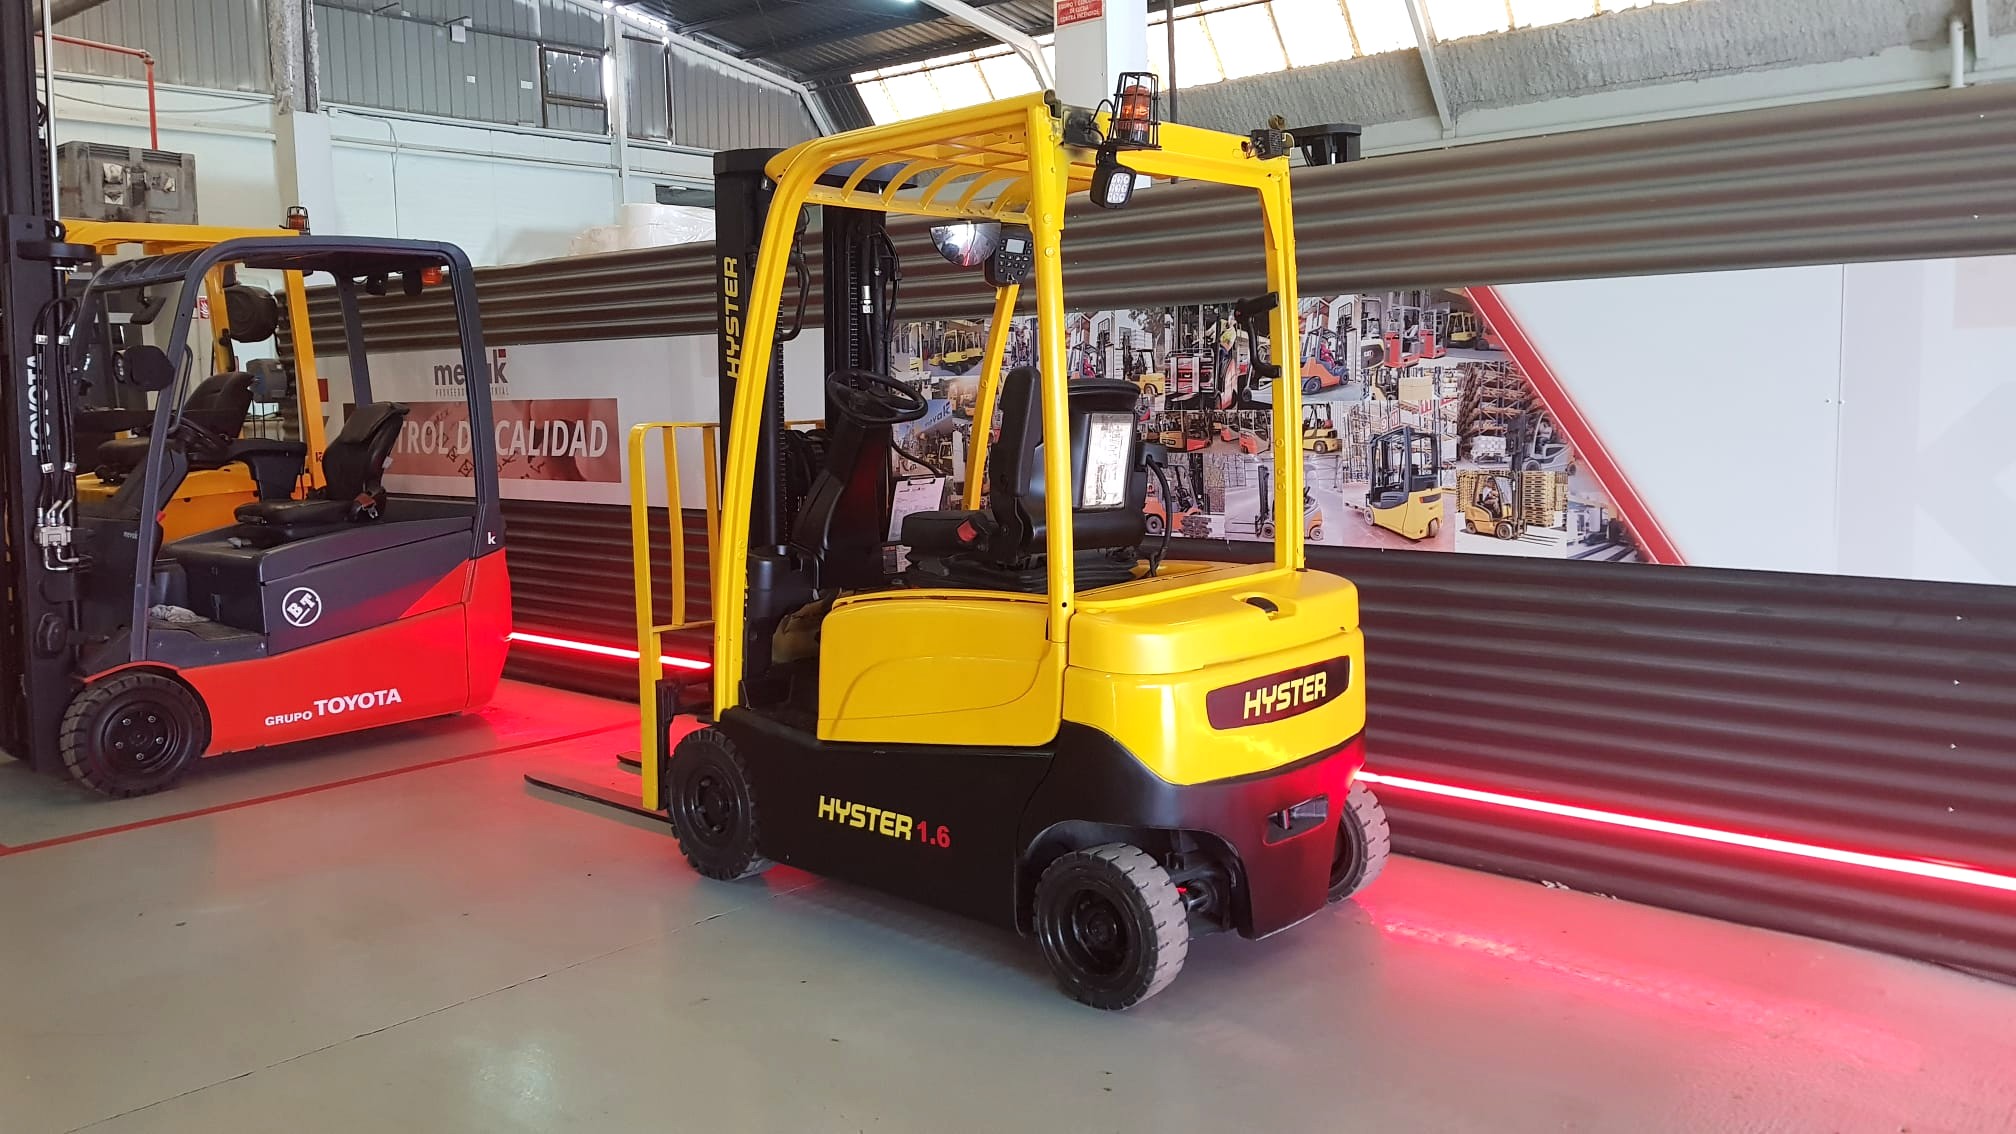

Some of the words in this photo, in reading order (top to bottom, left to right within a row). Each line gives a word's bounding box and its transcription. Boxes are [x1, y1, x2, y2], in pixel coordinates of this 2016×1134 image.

[723, 256, 741, 379] HYSTER
[434, 349, 509, 386] mek
[395, 420, 449, 455] TROL
[455, 420, 472, 455] D
[495, 419, 608, 457] CALIDAD
[265, 710, 313, 727] GRUPO
[314, 688, 402, 717] TOYOTA
[1243, 671, 1327, 720] HYSTER
[817, 795, 913, 841] HYSTER
[916, 820, 951, 848] 1.6
